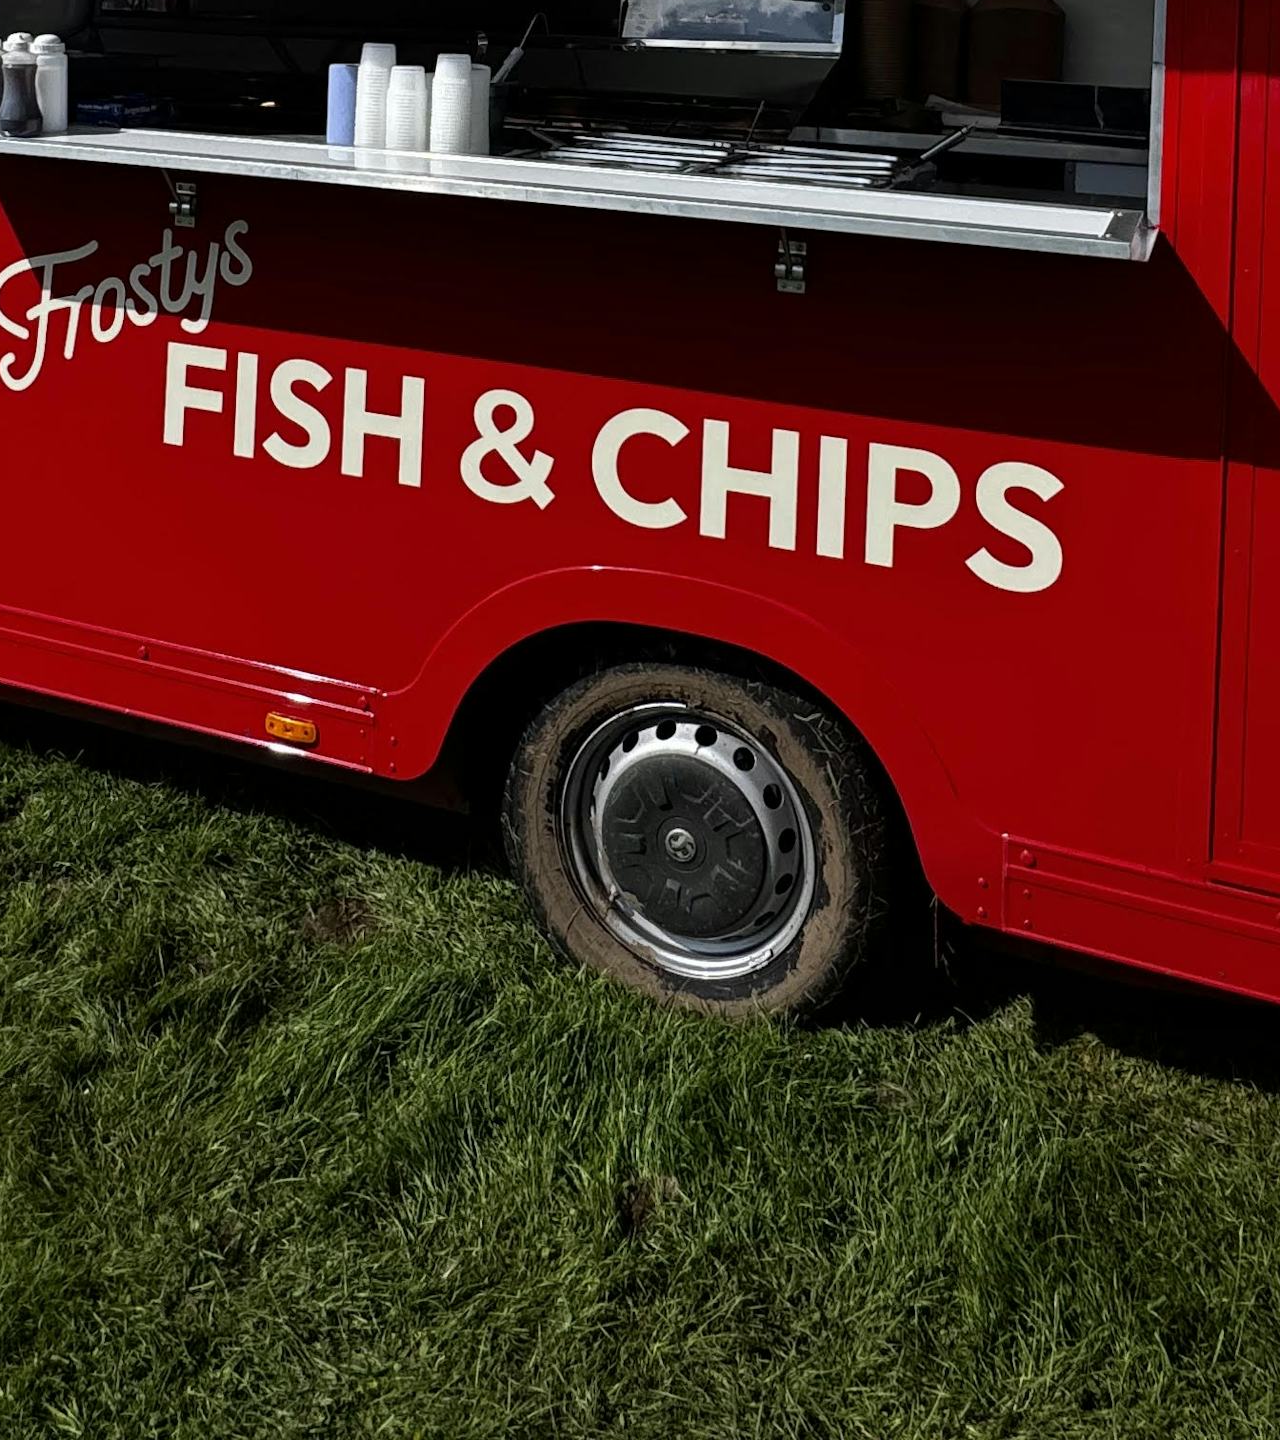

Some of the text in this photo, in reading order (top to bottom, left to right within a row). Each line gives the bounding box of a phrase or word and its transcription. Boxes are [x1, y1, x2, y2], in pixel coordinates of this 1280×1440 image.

[163, 341, 1064, 593] FISH & CHIPS
